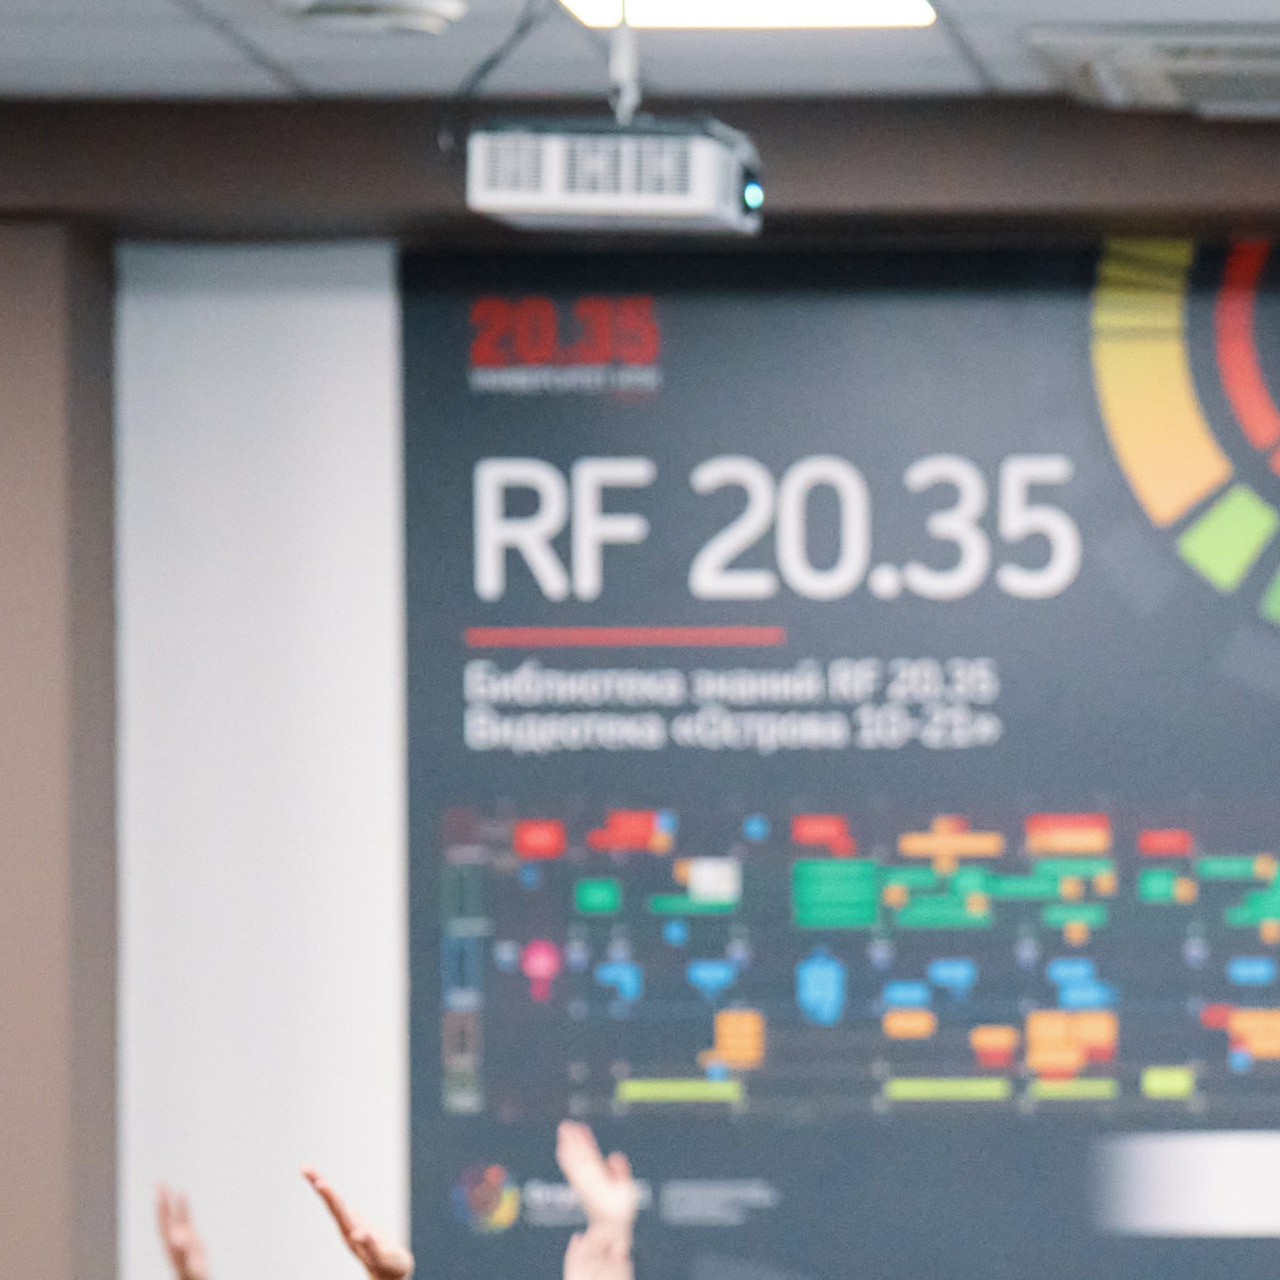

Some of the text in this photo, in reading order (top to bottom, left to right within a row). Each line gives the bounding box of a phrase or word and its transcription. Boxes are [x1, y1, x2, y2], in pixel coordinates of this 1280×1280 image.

[473, 454, 1084, 602] RF 20.35
[464, 659, 686, 706] Библиотека
[828, 658, 880, 704] RF
[887, 657, 999, 704] 20.35
